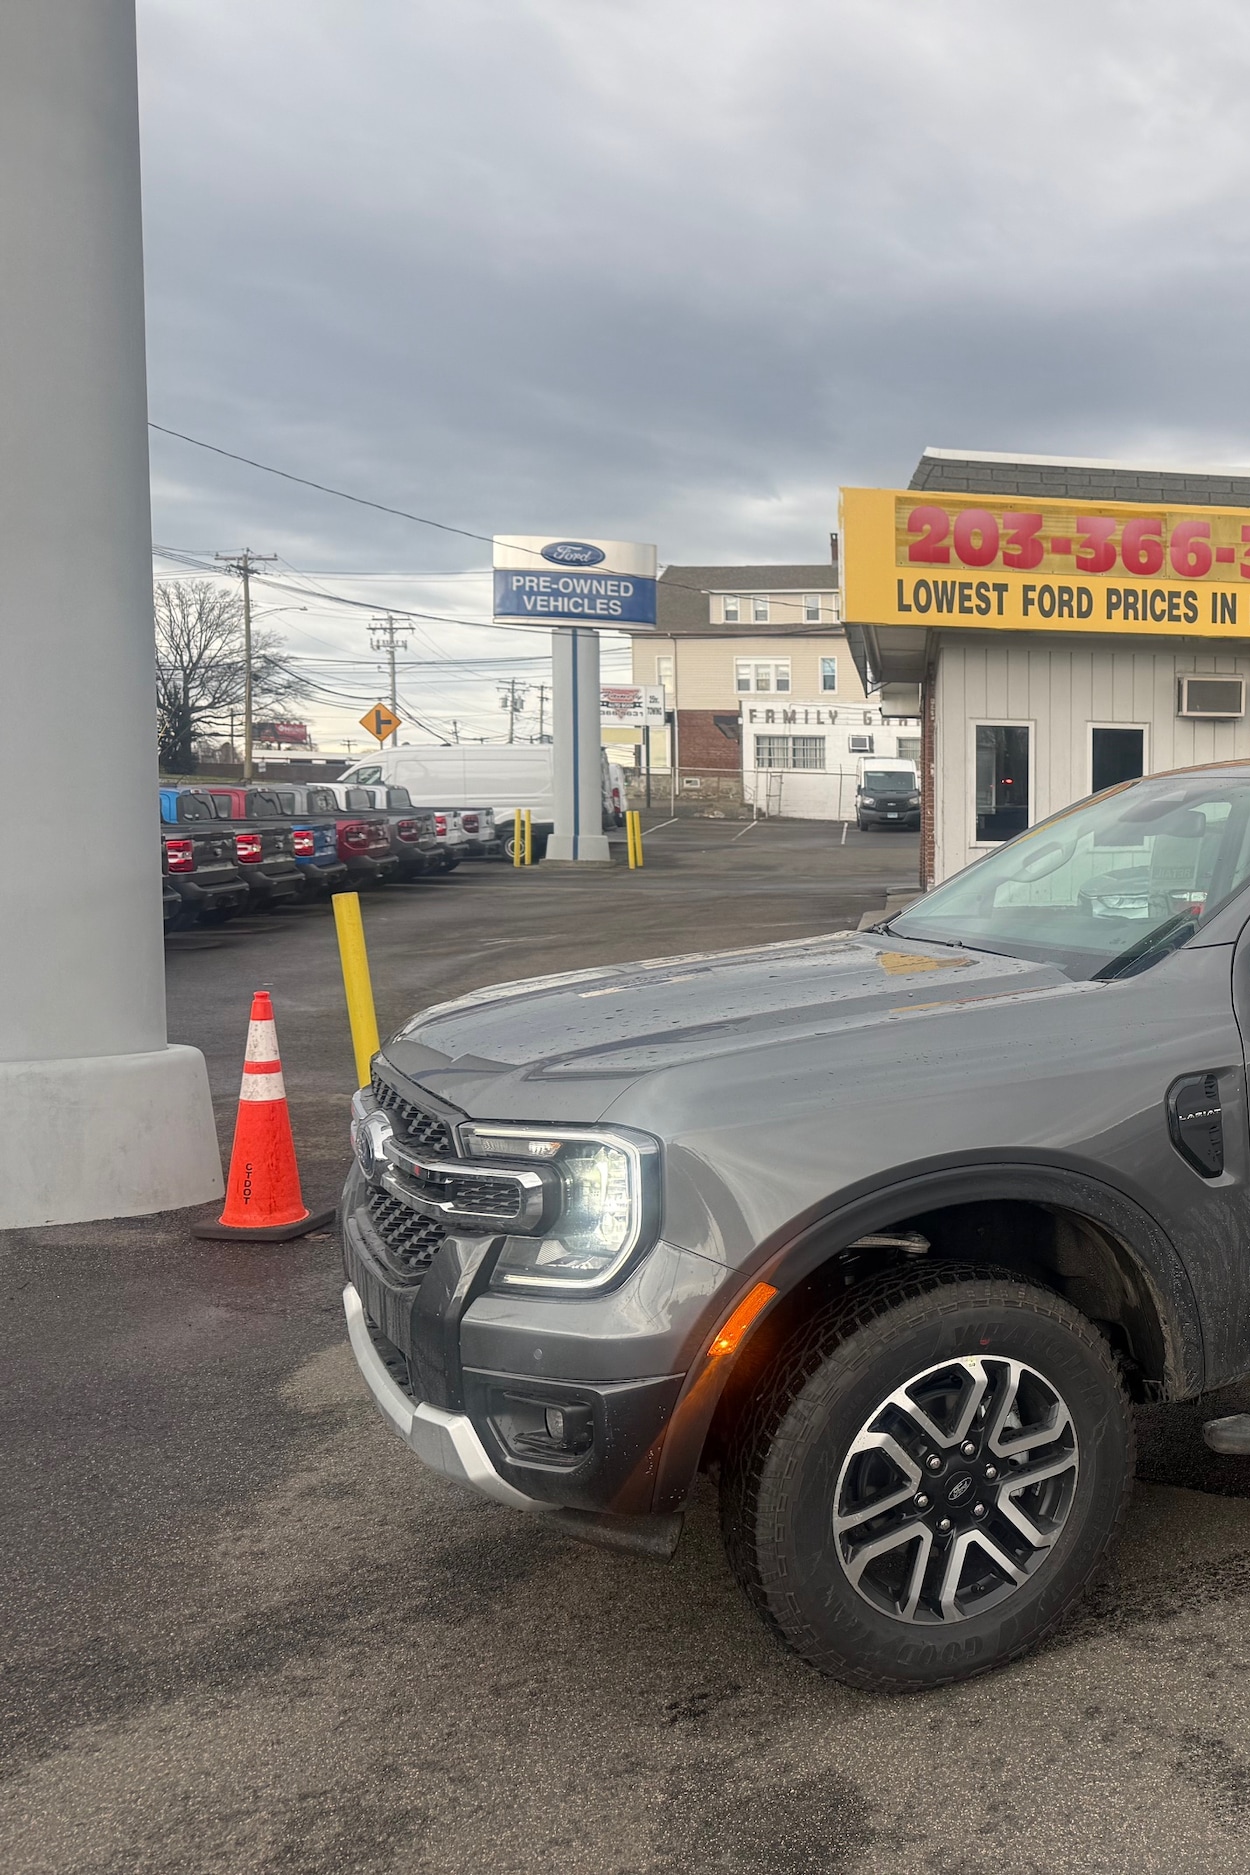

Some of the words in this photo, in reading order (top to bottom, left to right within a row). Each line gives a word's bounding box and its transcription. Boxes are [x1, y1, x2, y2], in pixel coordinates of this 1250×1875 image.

[553, 545, 592, 562] Ford
[512, 576, 634, 597] PRE-OWNED
[523, 595, 622, 615] VEHICLES
[897, 578, 1009, 616] LOWEST
[1022, 583, 1094, 619] FORD
[1106, 588, 1199, 624] PRICES
[1211, 592, 1237, 625] IN
[749, 709, 838, 725] FAMILY
